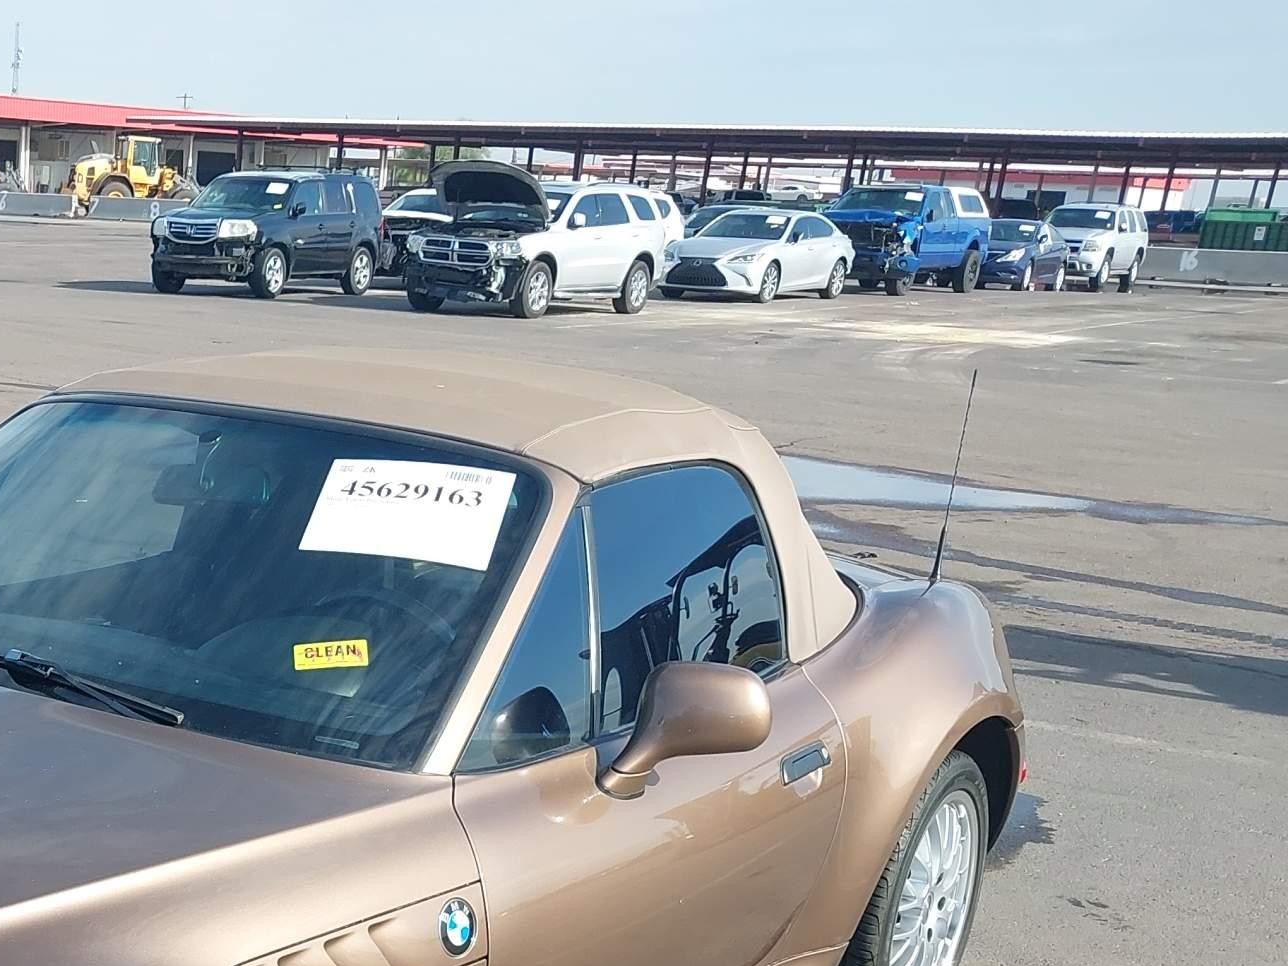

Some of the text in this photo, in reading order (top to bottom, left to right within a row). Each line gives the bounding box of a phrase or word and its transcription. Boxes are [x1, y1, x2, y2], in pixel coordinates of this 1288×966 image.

[1179, 251, 1198, 272] 16
[340, 480, 483, 508] 45629163
[304, 645, 356, 659] CLEAN
